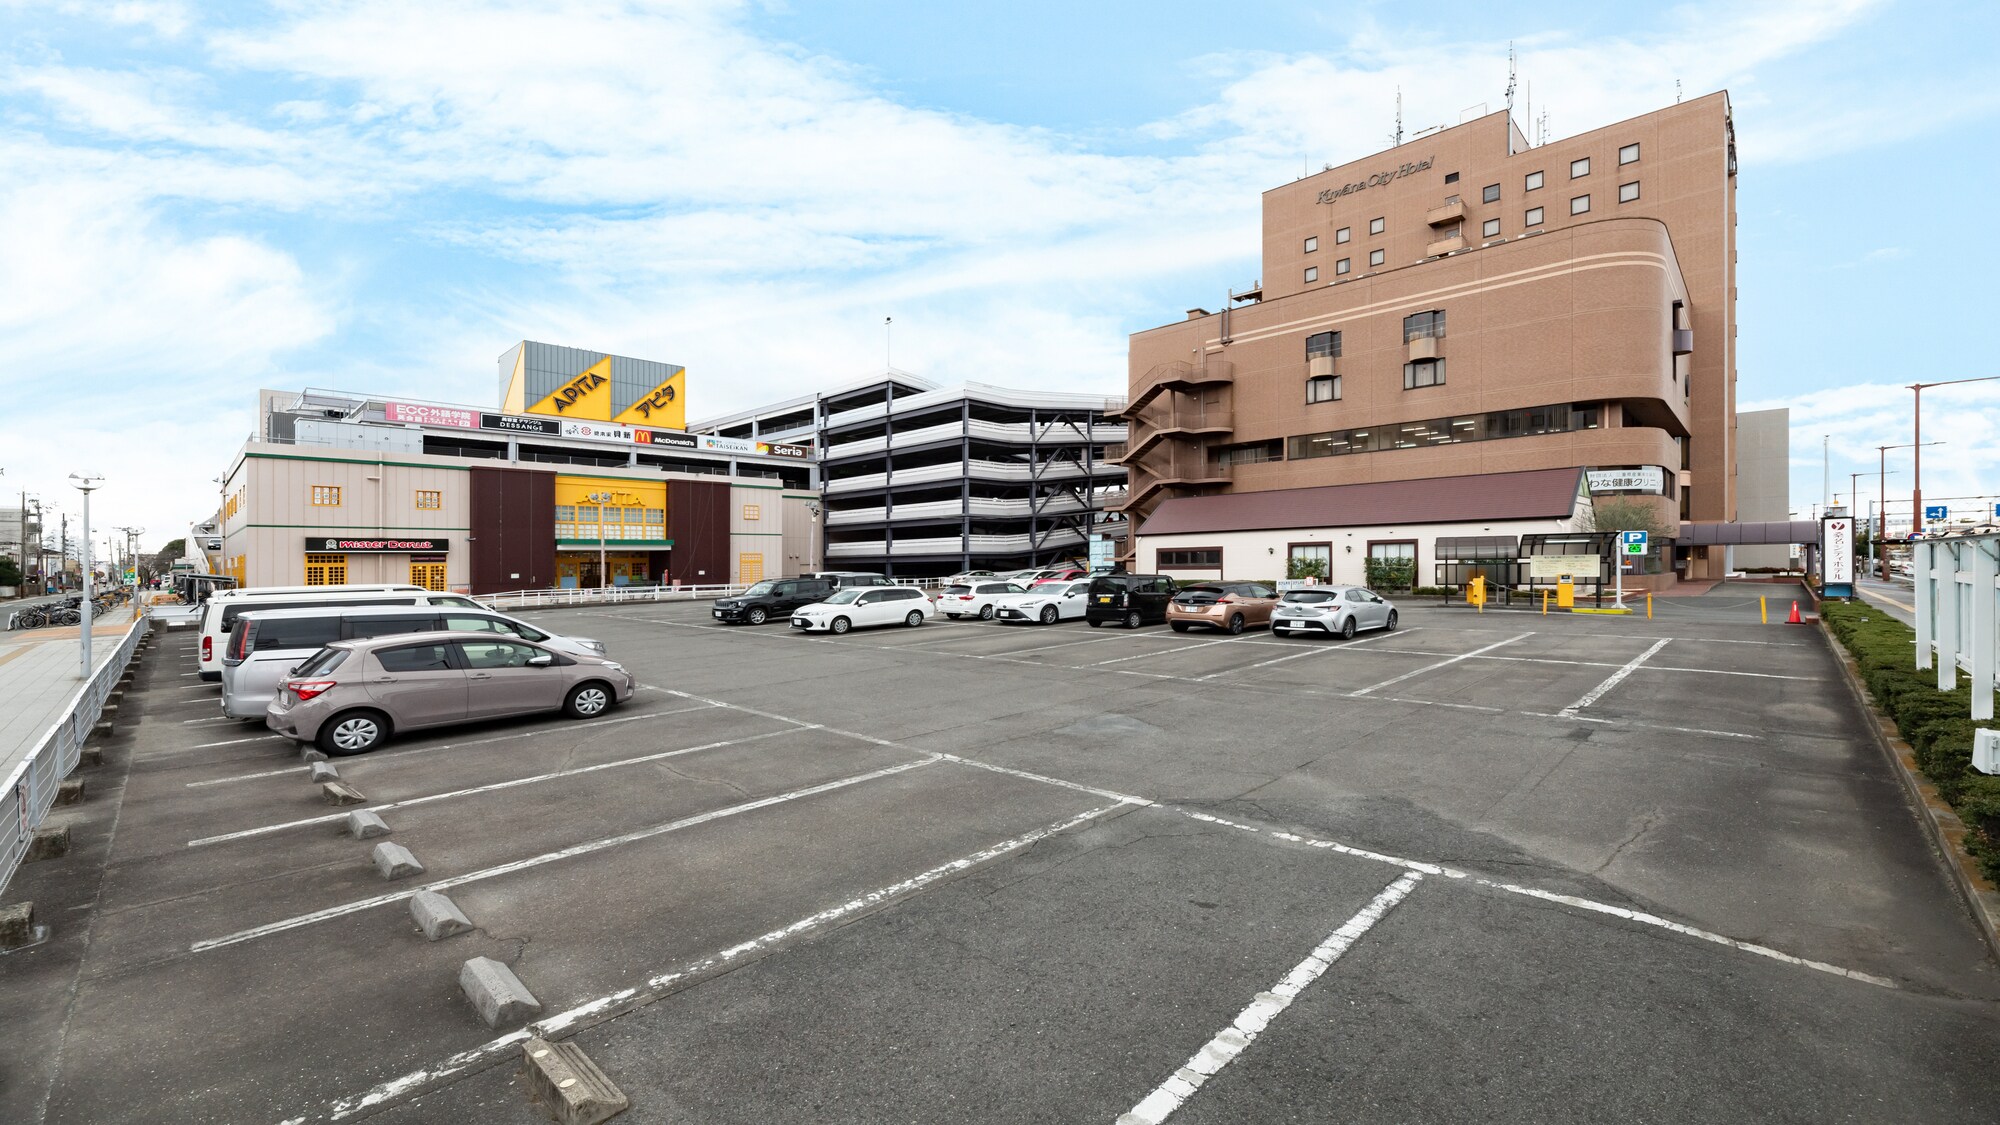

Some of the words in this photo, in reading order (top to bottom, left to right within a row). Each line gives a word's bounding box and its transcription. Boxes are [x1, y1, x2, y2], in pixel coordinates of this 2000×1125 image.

[1316, 181, 1367, 204] Kuwana
[1367, 171, 1397, 186] City
[1396, 155, 1435, 179] Hotel
[553, 372, 608, 413] APITA
[635, 384, 676, 418] アピタ
[499, 421, 544, 432] DESSANGE
[654, 437, 695, 447] McDonald's
[774, 445, 803, 457] Seria
[1628, 532, 1643, 543] P
[387, 540, 433, 549] Donut
[1833, 531, 1845, 581] 桑名シティホテル
